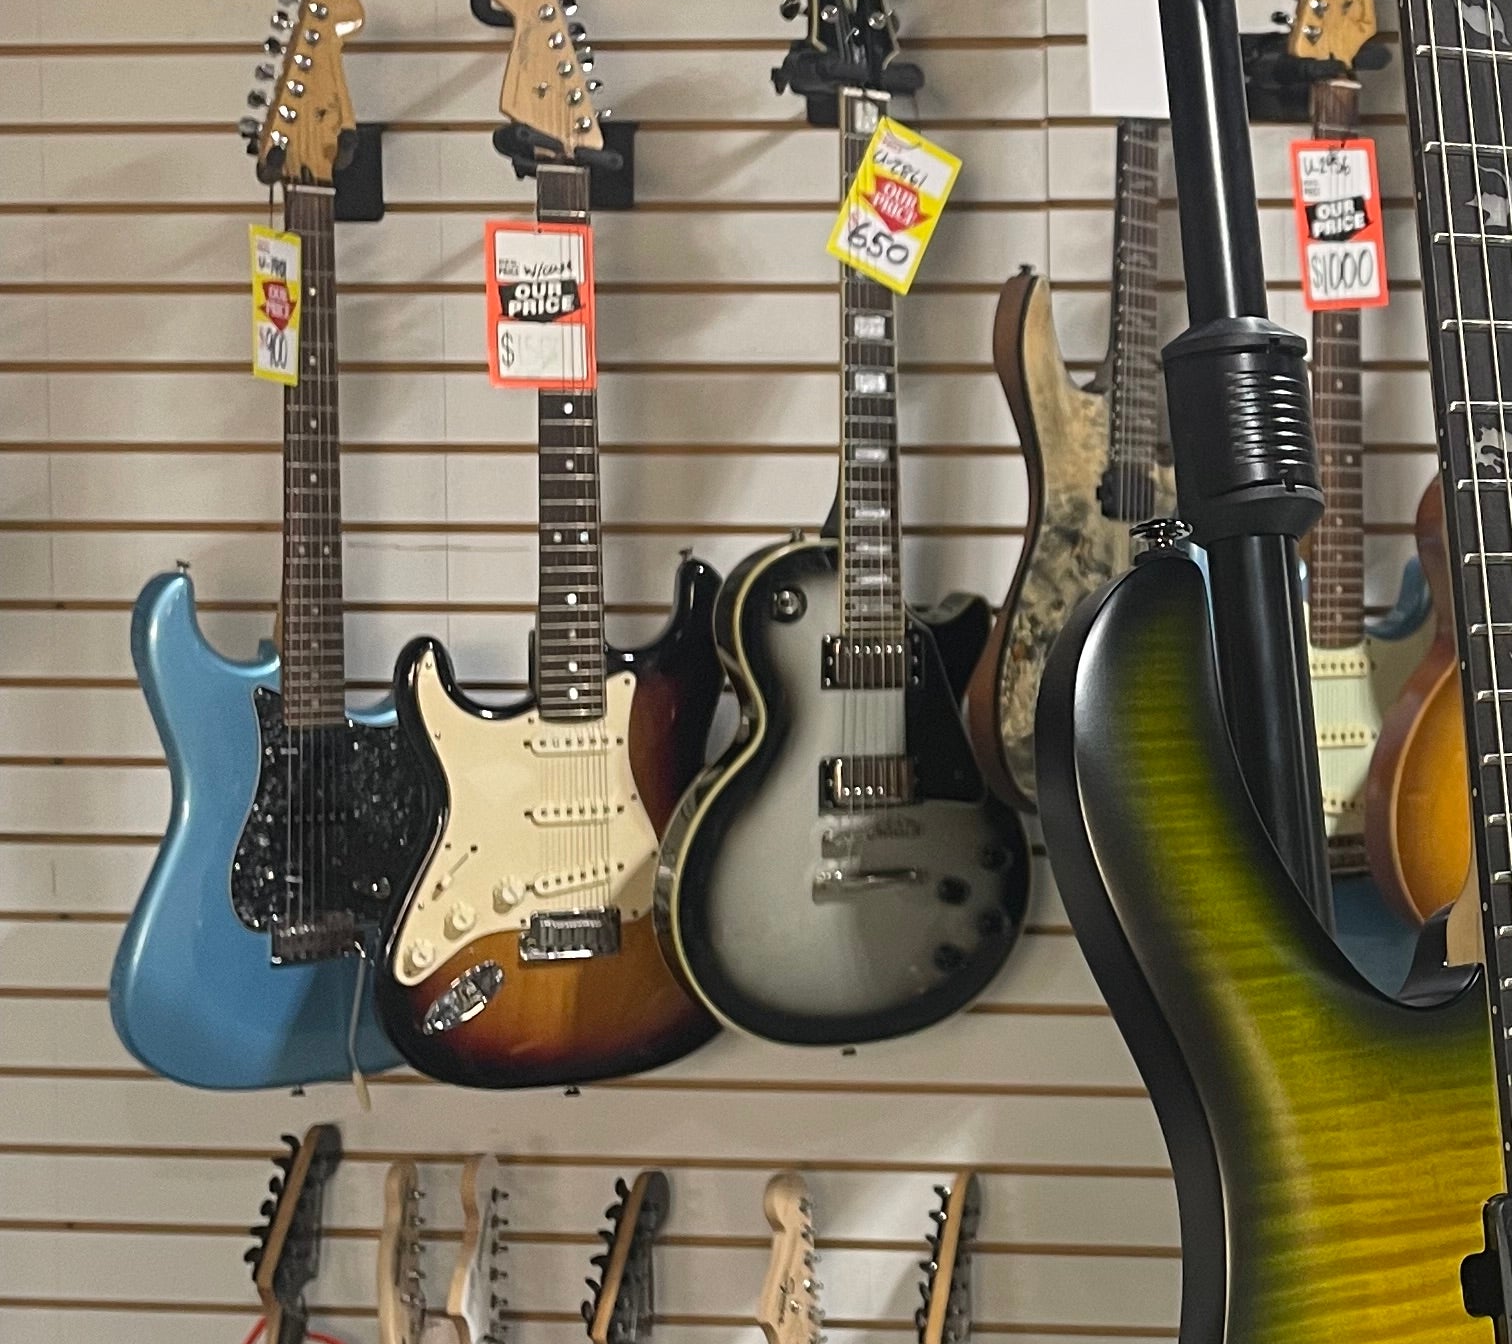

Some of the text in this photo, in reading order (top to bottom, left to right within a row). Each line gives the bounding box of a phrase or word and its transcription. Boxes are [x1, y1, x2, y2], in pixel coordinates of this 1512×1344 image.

[882, 180, 918, 207] OUR
[872, 191, 919, 226] PRICE
[1315, 198, 1356, 221] OUR
[1311, 212, 1366, 239] PRICE
[1311, 248, 1374, 296] $1000
[514, 280, 562, 301] OUR
[508, 294, 575, 318] PRICE
